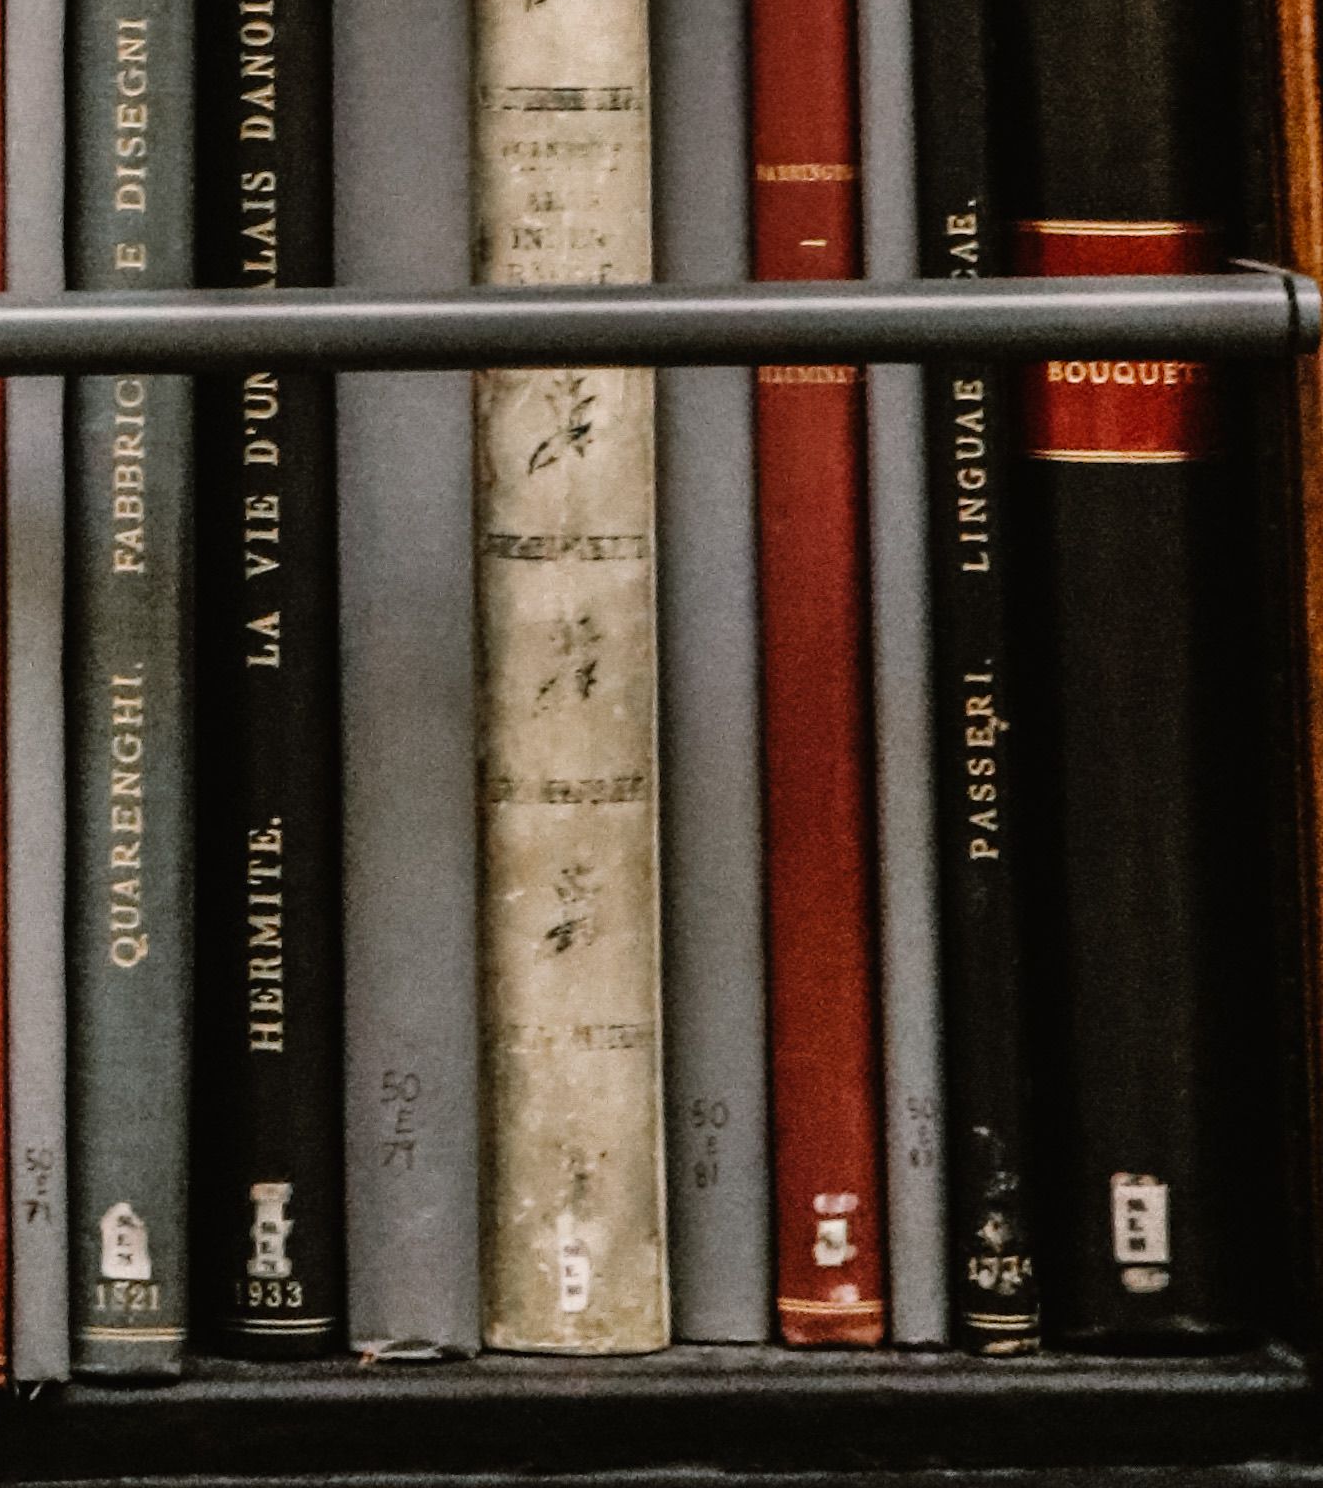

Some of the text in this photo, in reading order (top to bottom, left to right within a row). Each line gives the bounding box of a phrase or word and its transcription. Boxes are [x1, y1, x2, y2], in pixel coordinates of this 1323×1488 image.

[116, 18, 149, 214] DISEGNI
[116, 242, 146, 272] E
[113, 377, 145, 575] FABBRIC
[246, 494, 279, 580] VIE
[247, 609, 280, 670] LA
[955, 376, 1000, 862] PASSERI. LINGUAE
[111, 660, 147, 968] QUARENGHI.
[249, 815, 284, 1054] HERMITE.
[381, 1069, 420, 1103] 50
